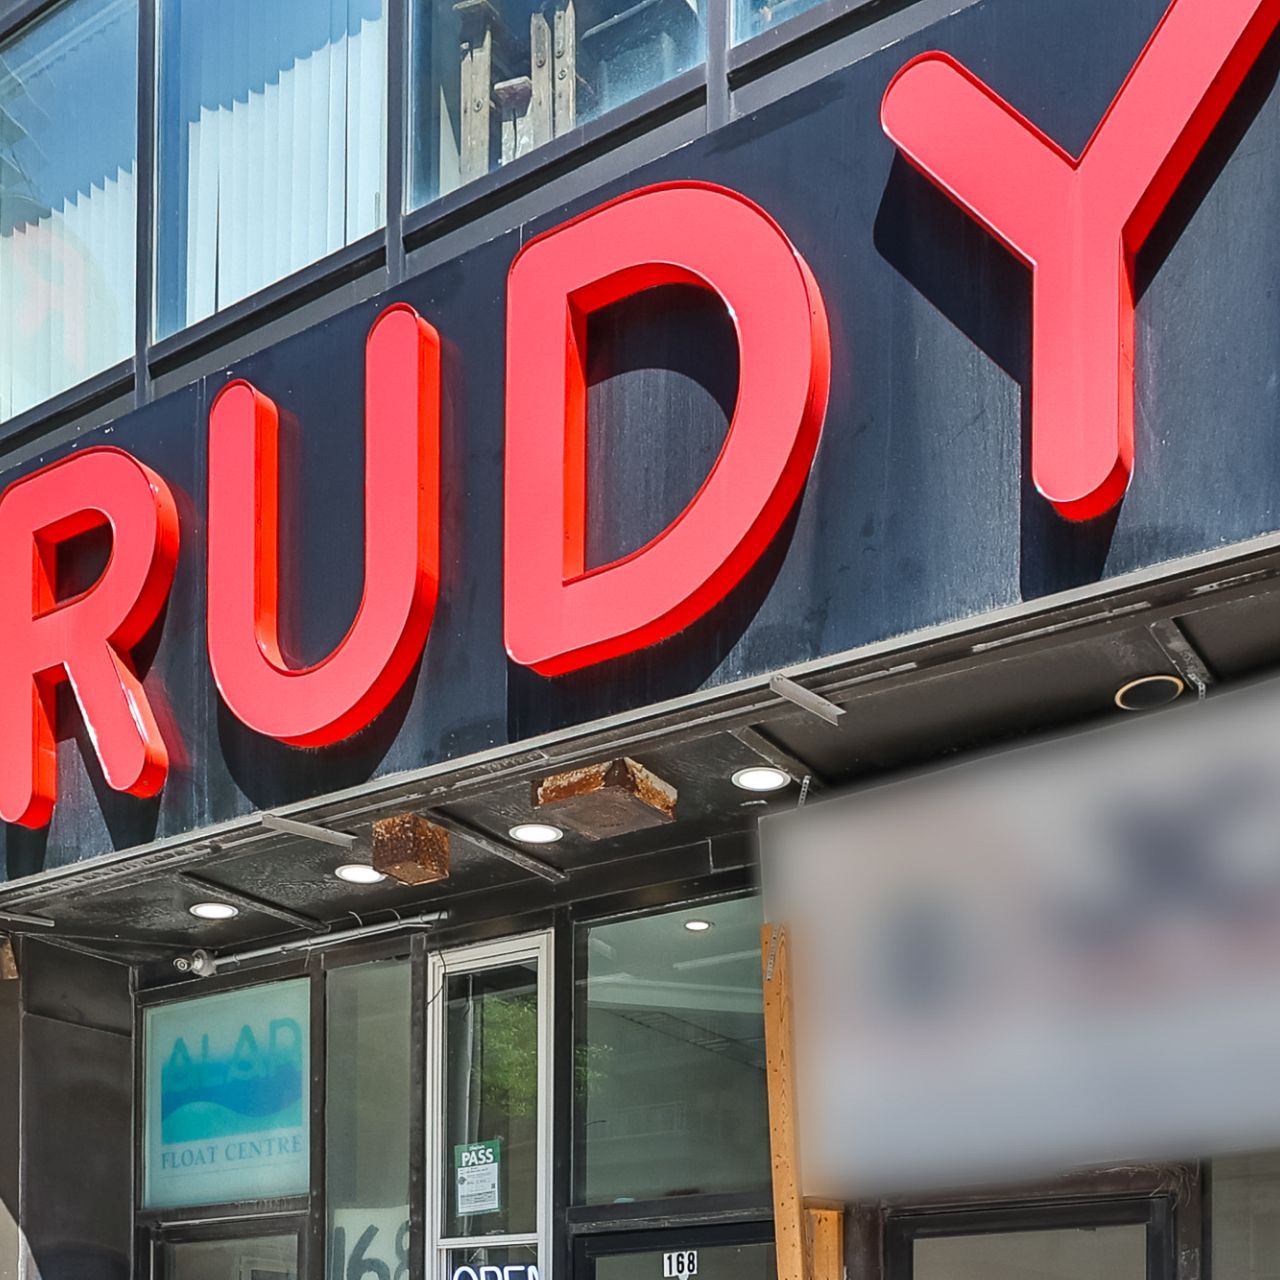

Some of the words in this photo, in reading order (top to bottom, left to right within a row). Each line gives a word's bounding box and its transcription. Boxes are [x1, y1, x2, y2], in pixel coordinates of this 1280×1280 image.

[161, 1144, 219, 1170] FLOAT
[224, 1134, 302, 1162] CENTRE
[462, 1148, 494, 1167] PASS
[666, 1251, 696, 1277] 168
